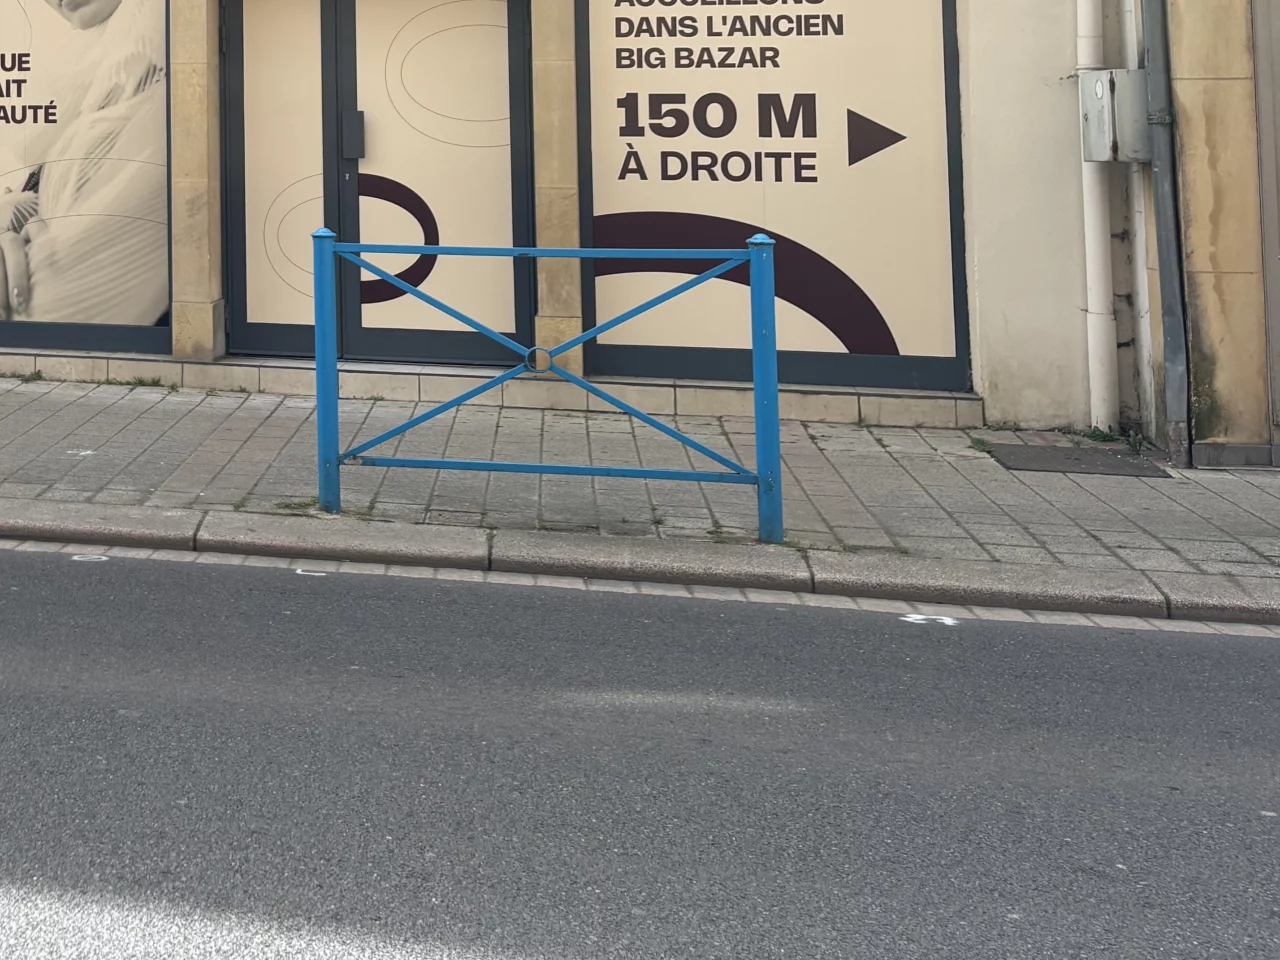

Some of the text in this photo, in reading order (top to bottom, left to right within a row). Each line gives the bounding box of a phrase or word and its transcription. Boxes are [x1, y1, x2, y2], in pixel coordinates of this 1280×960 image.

[615, 14, 844, 37] DANS L'ANCIEN
[615, 47, 780, 68] BIG BAZAR
[616, 92, 817, 138] 150 M
[618, 143, 818, 182] À DROITE
